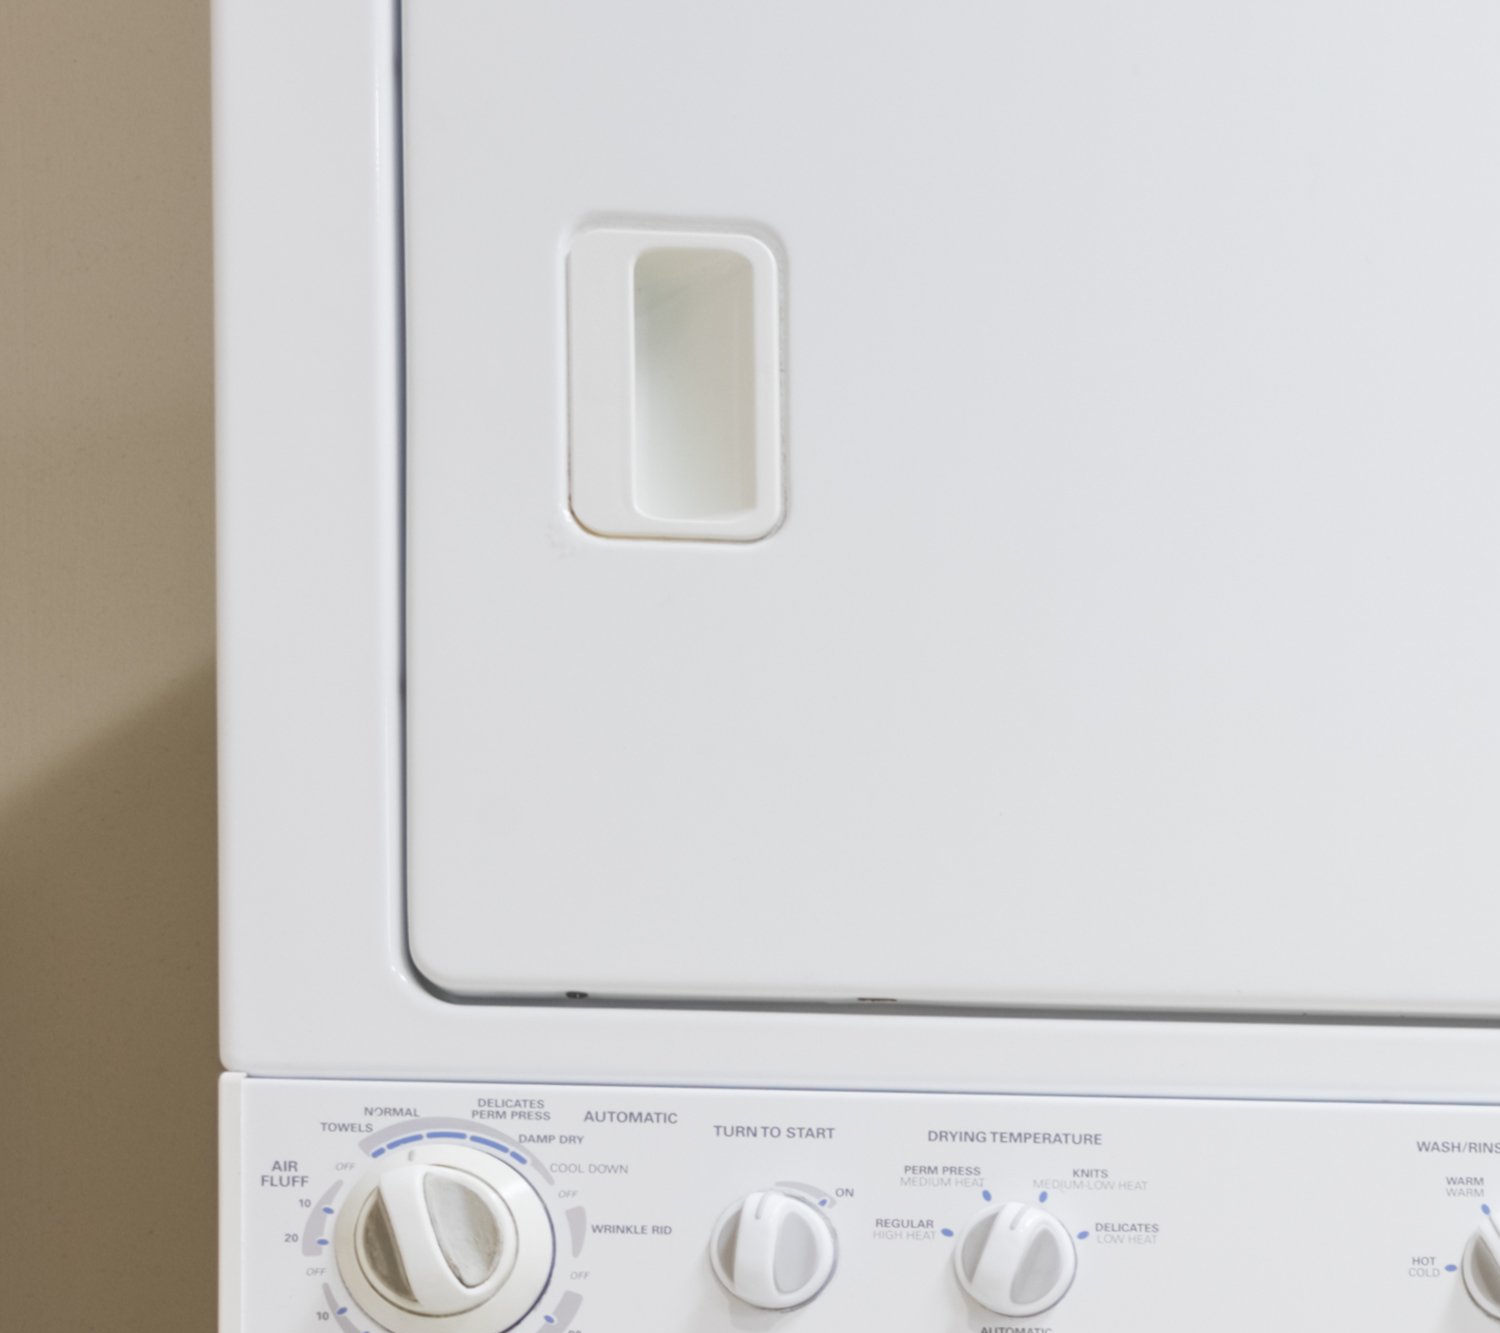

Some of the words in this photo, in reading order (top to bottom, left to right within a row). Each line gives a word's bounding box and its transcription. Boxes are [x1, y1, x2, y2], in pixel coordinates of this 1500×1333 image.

[478, 1098, 544, 1109] DELICATES
[364, 1106, 419, 1117] NORMAL
[472, 1109, 508, 1120] PERM
[512, 1110, 550, 1121] PRESS
[584, 1111, 678, 1125] AUTOMATIC
[321, 1122, 373, 1133] TOWELS
[714, 1125, 757, 1138] TURN
[761, 1125, 781, 1139] TO
[786, 1126, 835, 1139] START
[518, 1133, 555, 1144] DAMP
[559, 1134, 584, 1145] DRY
[928, 1130, 986, 1144] DRYING
[990, 1131, 1102, 1145] TEMPERATURE
[272, 1160, 298, 1173] AIR
[550, 1163, 584, 1174] COOL
[588, 1163, 628, 1175] DOWN
[904, 1165, 938, 1175] PERM
[942, 1166, 981, 1176] PRESS
[1072, 1168, 1108, 1179] KNITS
[261, 1174, 309, 1188] FLUFF
[900, 1177, 949, 1187] MEDIUM
[953, 1178, 984, 1188] HEAT
[1033, 1179, 1114, 1190] MEDIUM-LOW
[1118, 1181, 1148, 1191] HEAT
[1445, 1176, 1484, 1187] WARM
[835, 1188, 854, 1198] ON
[1445, 1187, 1485, 1198] WARM
[300, 1199, 311, 1208] 10
[591, 1224, 647, 1235] WRINKLE
[650, 1224, 672, 1235] RID
[876, 1219, 934, 1229] REGULAR
[1095, 1223, 1159, 1233] DELICATES
[284, 1233, 299, 1242] 20
[873, 1230, 902, 1241] HIGH
[906, 1230, 936, 1241] HEAT
[1096, 1234, 1122, 1244] LOW
[1126, 1234, 1157, 1245] HEAT
[1411, 1256, 1436, 1267] HOT
[1408, 1267, 1441, 1278] COLD
[316, 1311, 329, 1321] 10
